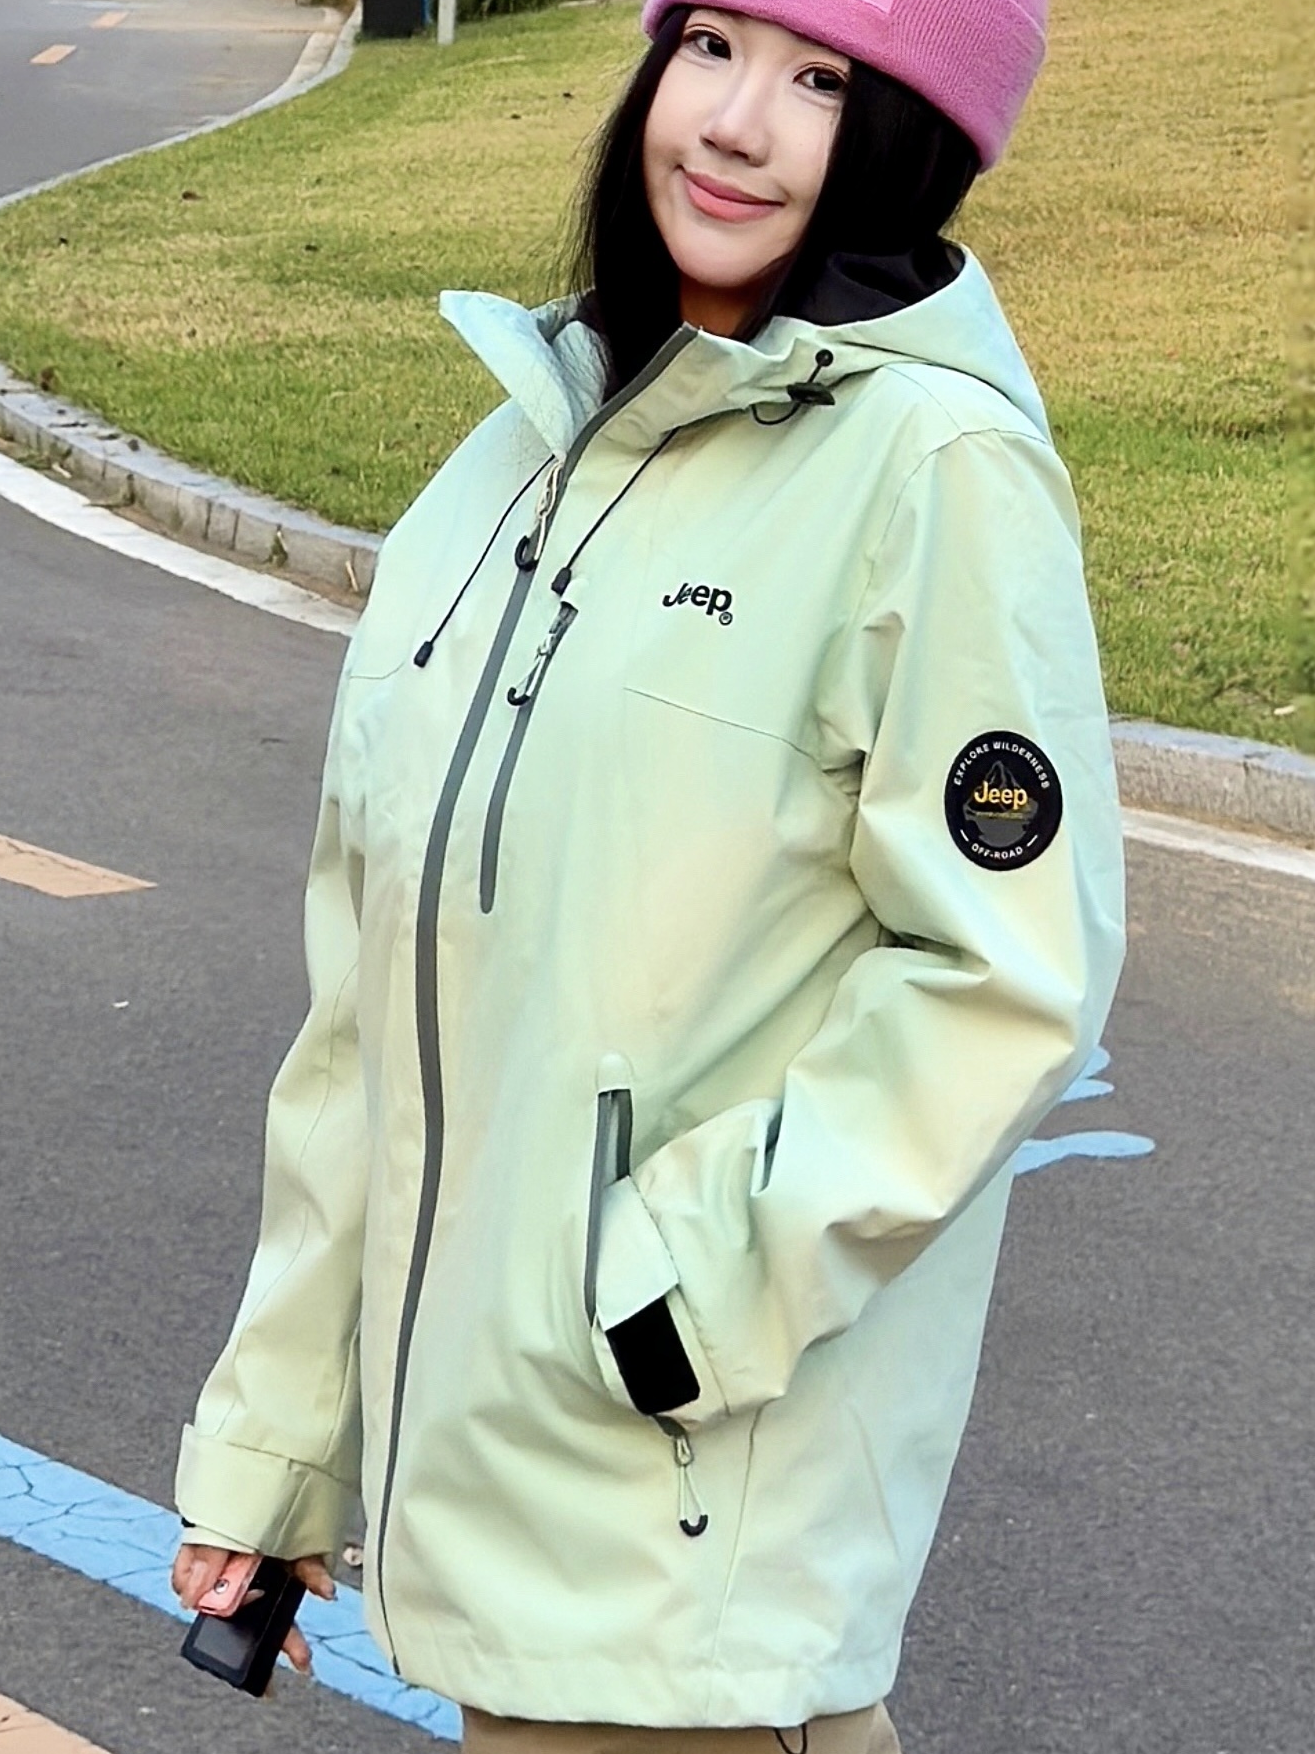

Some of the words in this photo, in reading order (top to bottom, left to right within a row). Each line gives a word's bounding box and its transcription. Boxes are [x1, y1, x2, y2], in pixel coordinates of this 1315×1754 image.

[953, 743, 990, 786] EXPLORE
[992, 741, 1051, 789] WILDERNESS
[973, 781, 1028, 810] Jeep
[971, 842, 1024, 860] OFF-ROAD
